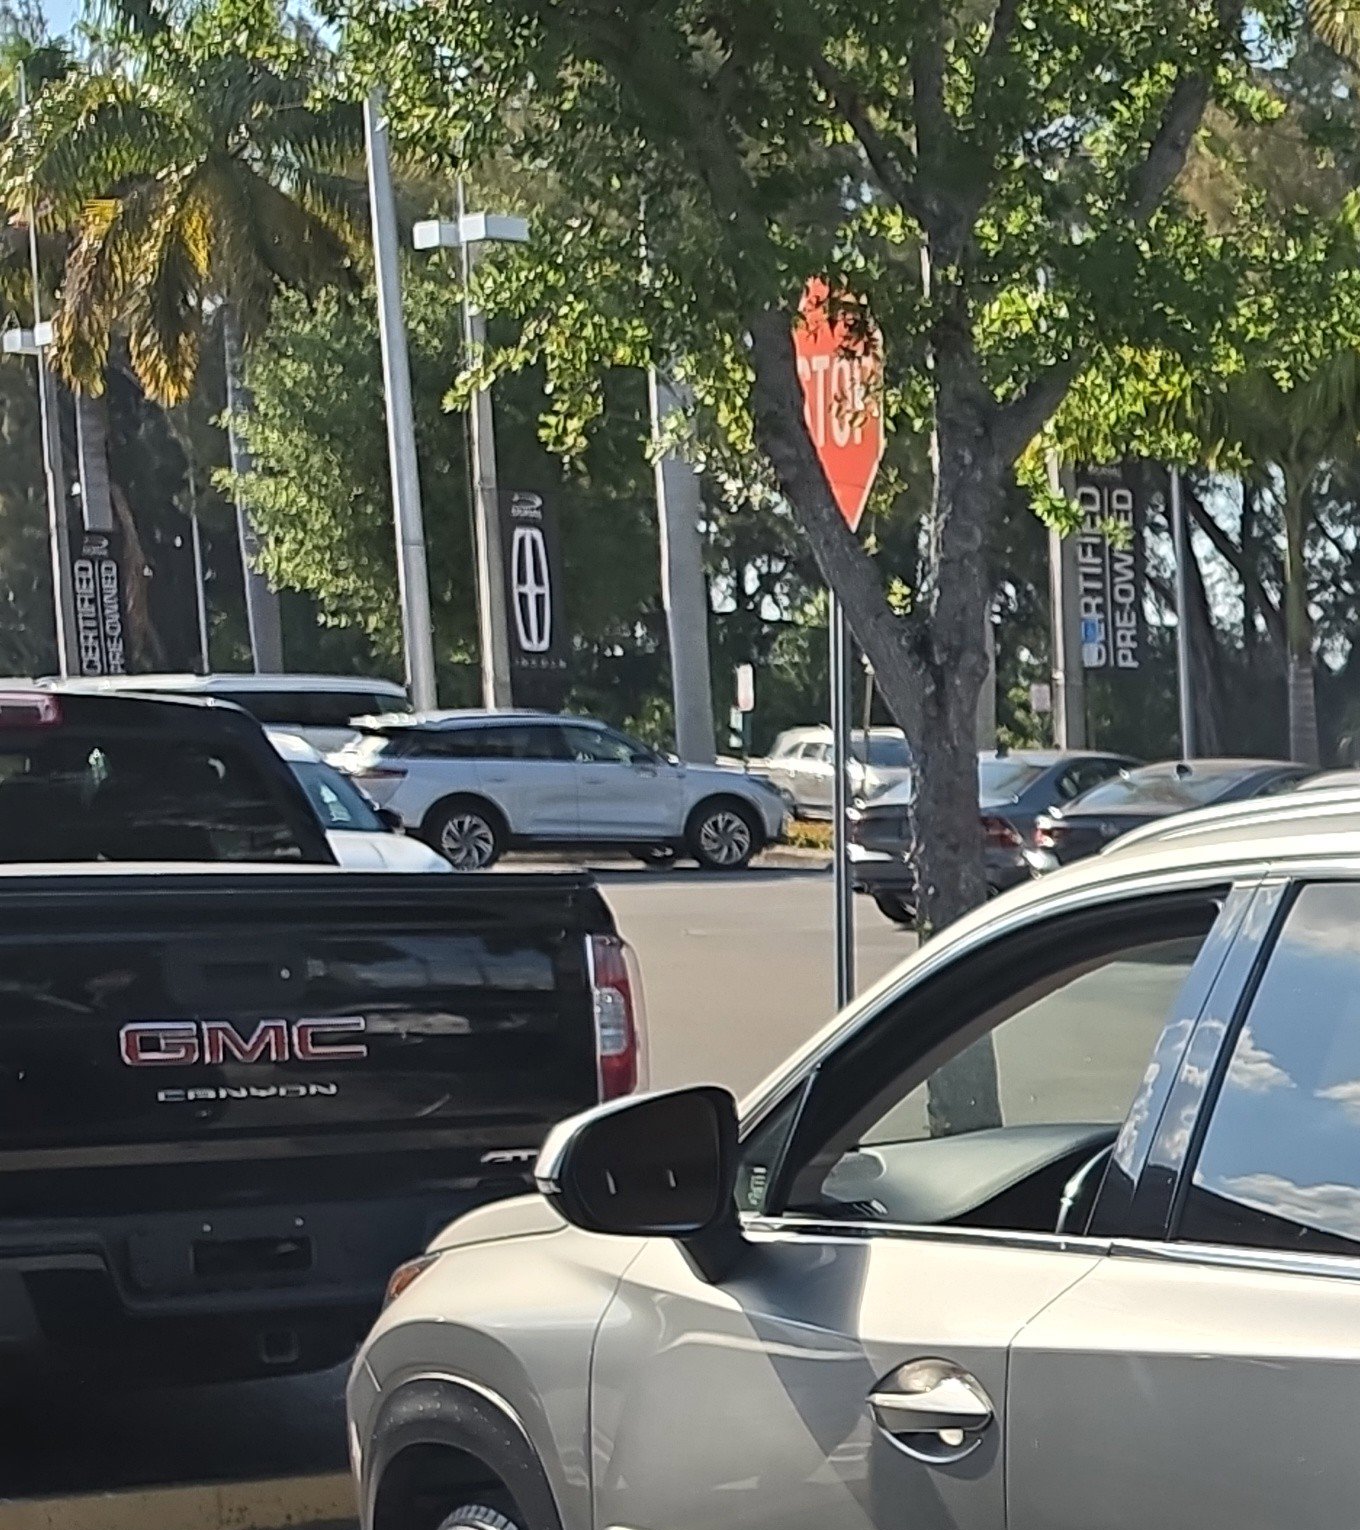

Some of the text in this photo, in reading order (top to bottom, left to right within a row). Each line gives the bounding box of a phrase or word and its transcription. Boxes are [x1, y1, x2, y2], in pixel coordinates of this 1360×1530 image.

[798, 354, 876, 448] TO
[1112, 488, 1140, 669] PRE-OWED
[119, 1016, 368, 1066] GMC
[157, 1082, 338, 1102] CANYON
